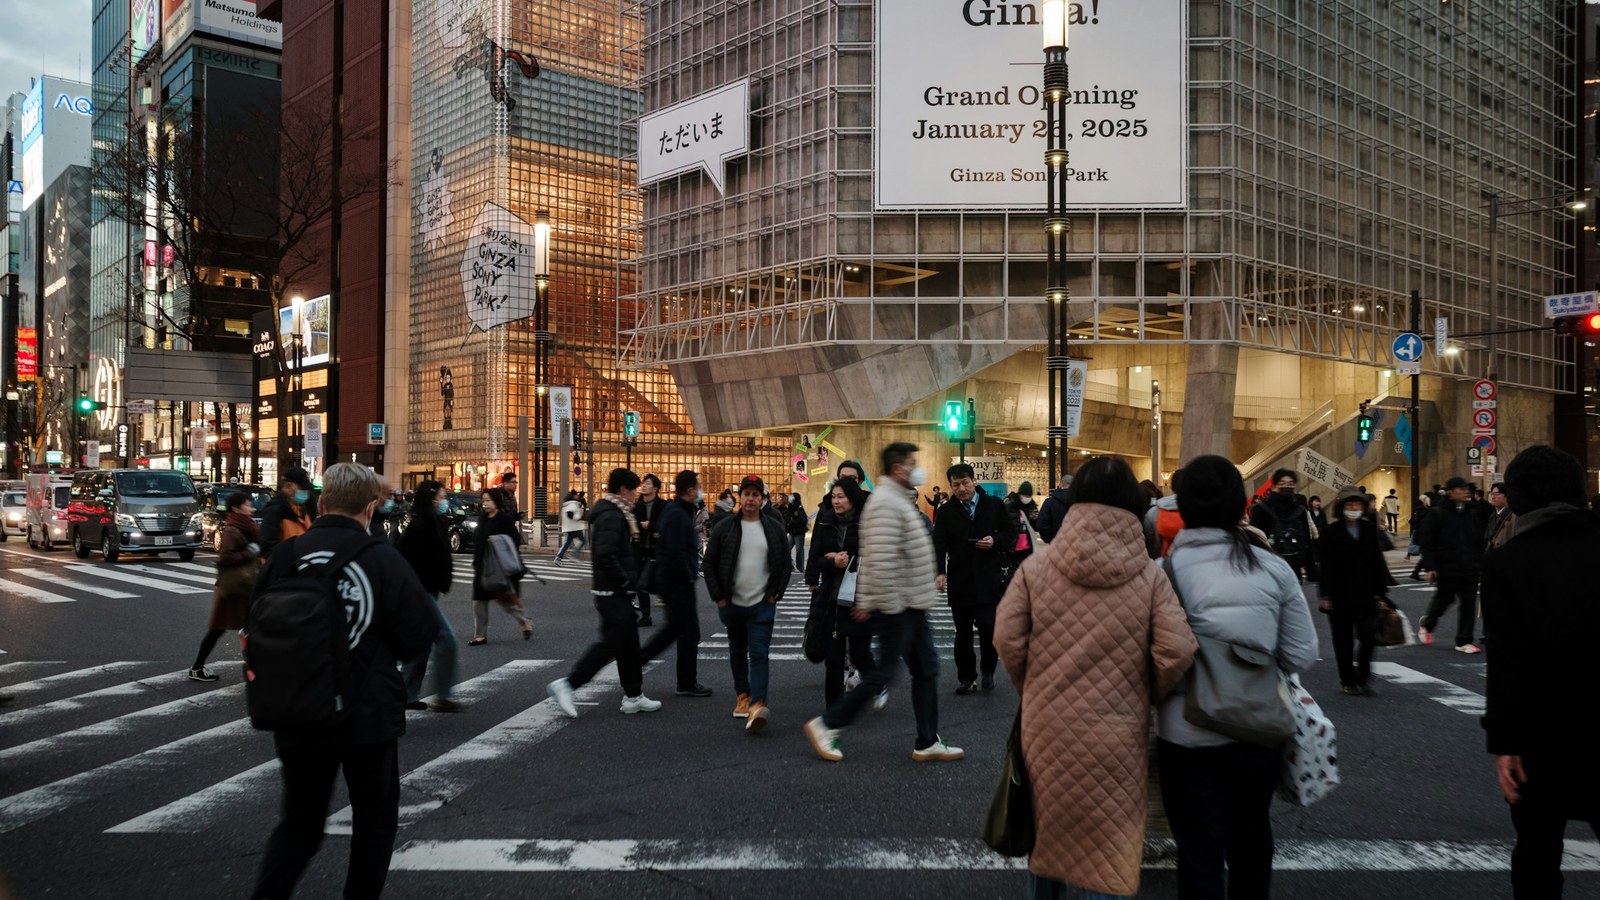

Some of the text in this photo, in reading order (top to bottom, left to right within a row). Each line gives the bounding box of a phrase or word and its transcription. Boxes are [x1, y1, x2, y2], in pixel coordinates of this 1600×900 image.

[963, 0, 1098, 26] Gina!
[231, 15, 278, 33] Holdings
[924, 86, 1010, 106] Grand
[659, 112, 723, 155] ただいま
[912, 120, 1025, 143] January
[1081, 119, 1148, 137] 2025
[950, 168, 1006, 182] Ginza
[1065, 168, 1109, 181] Park
[479, 243, 516, 272] GINZA
[472, 262, 503, 286] SONY
[474, 284, 508, 312] PARK!
[964, 460, 990, 471] ony
[1306, 451, 1320, 467] Sony
[991, 462, 1004, 480] 展
[1303, 463, 1317, 477] Park
[1317, 461, 1329, 482] 展
[1334, 467, 1348, 483] Sony
